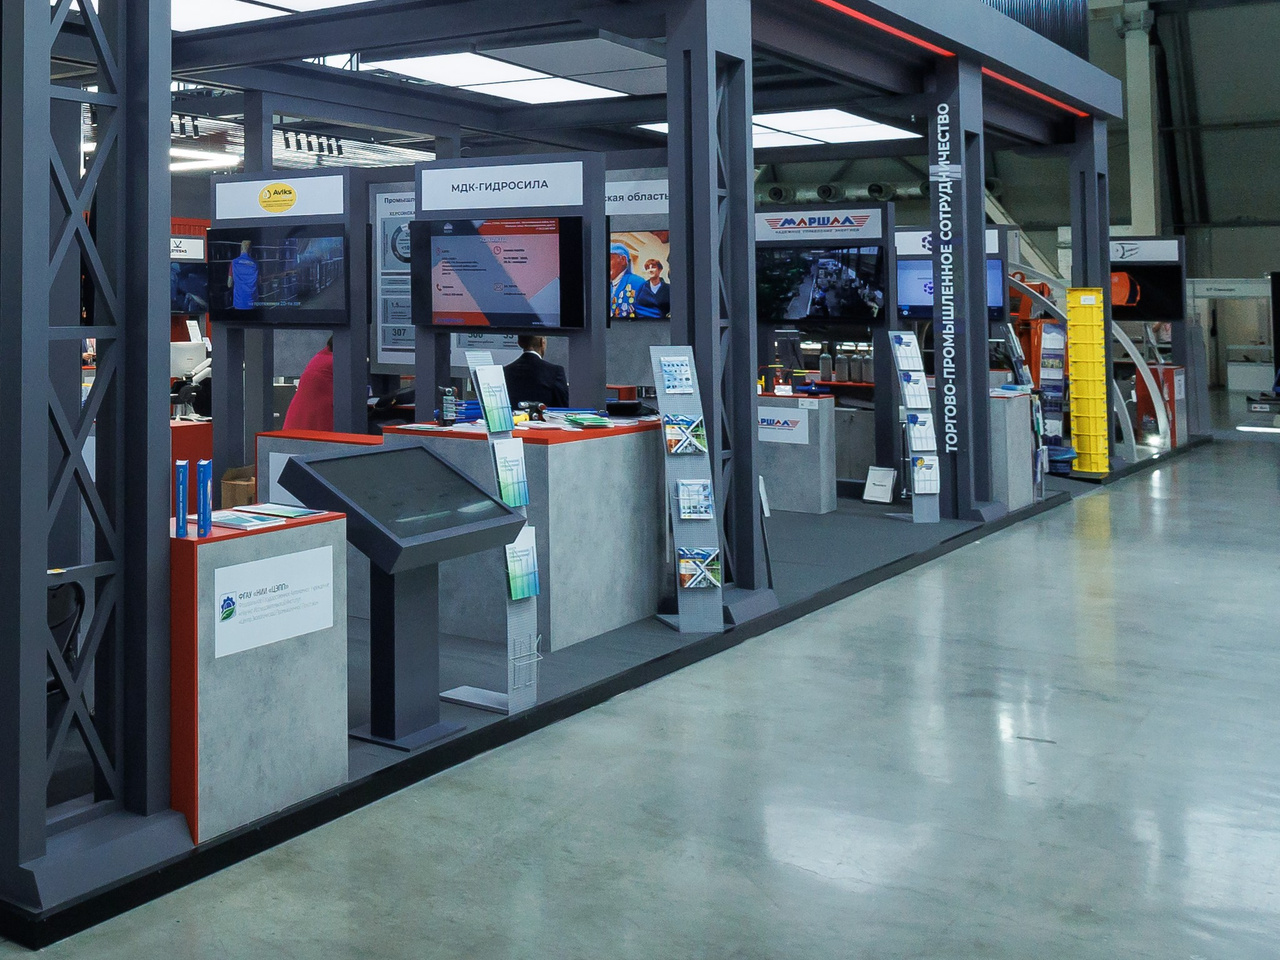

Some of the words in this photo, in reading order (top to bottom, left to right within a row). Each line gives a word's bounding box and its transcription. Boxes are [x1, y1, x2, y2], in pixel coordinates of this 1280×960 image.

[937, 103, 952, 240] СОТРУДНИЧЕСТВО
[451, 179, 549, 193] МДК-ГИДРОСИЛА
[627, 192, 669, 202] область
[940, 244, 958, 453] ТОРГОВО-ПРОМЫШЛЕННОЕ
[758, 418, 790, 426] РШАЛ
